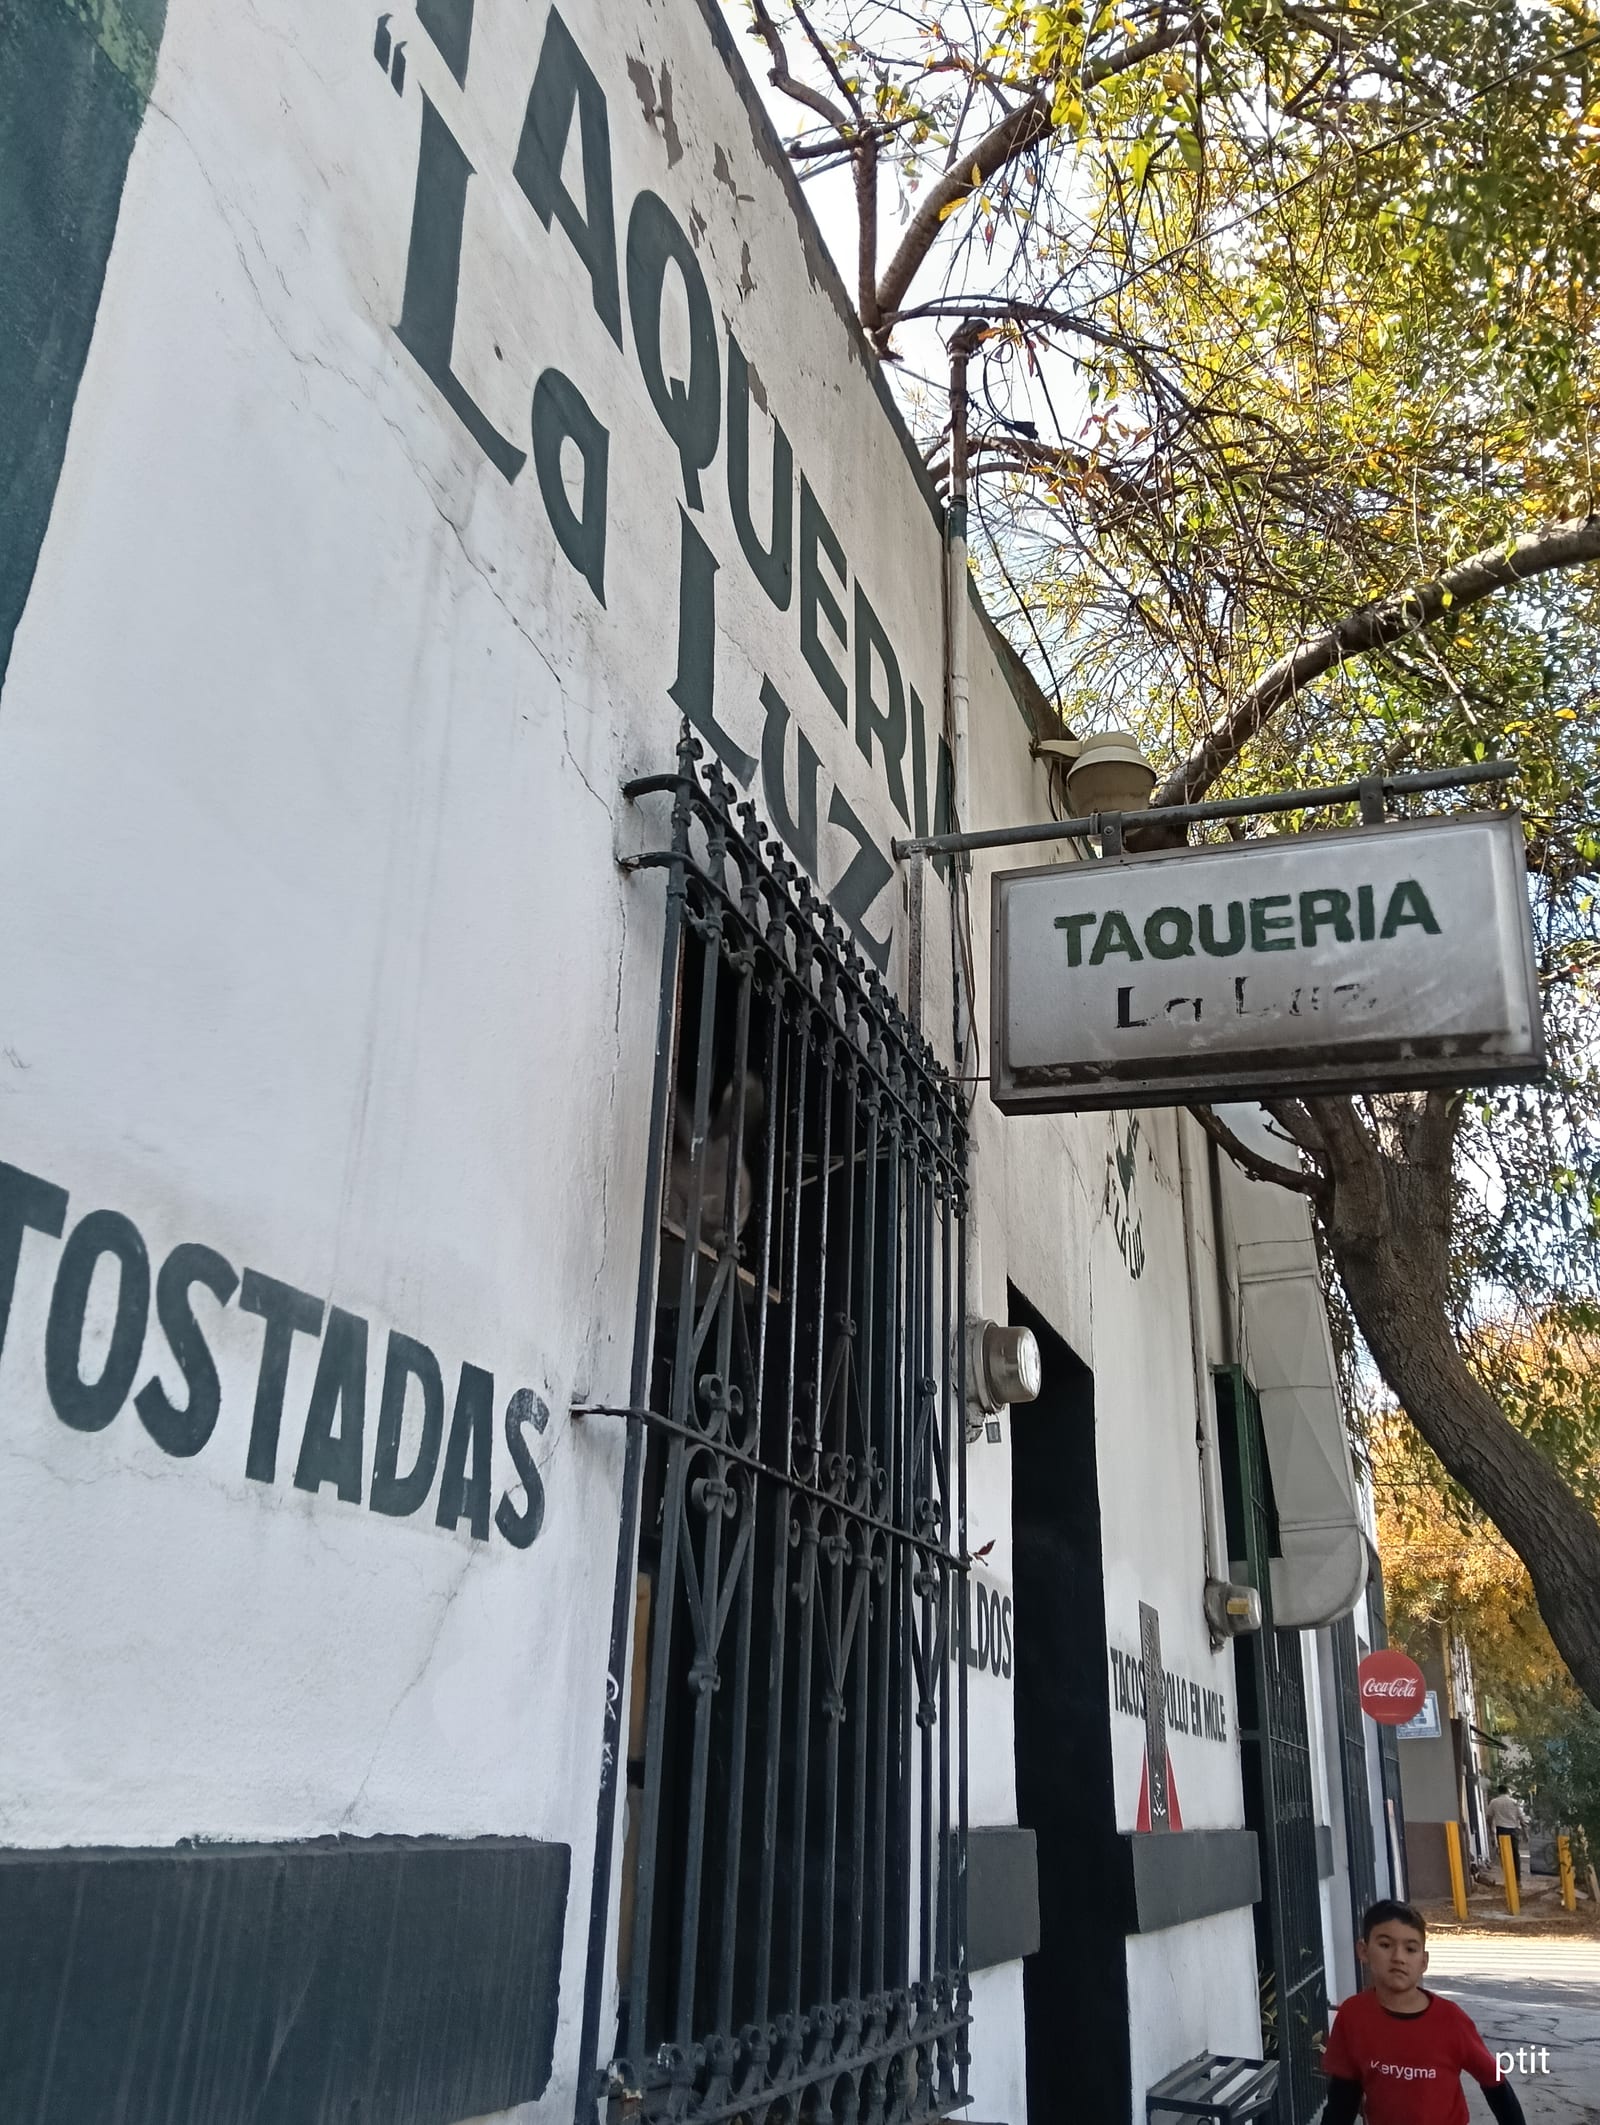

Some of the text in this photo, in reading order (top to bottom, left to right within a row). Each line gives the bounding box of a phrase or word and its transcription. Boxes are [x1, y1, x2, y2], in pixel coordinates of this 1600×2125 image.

[1053, 879, 1443, 967] TAQUERIA
[1114, 985, 1202, 1029] La
[1363, 1677, 1418, 1698] Coca-Cola
[1202, 1687, 1227, 1743] MOLE
